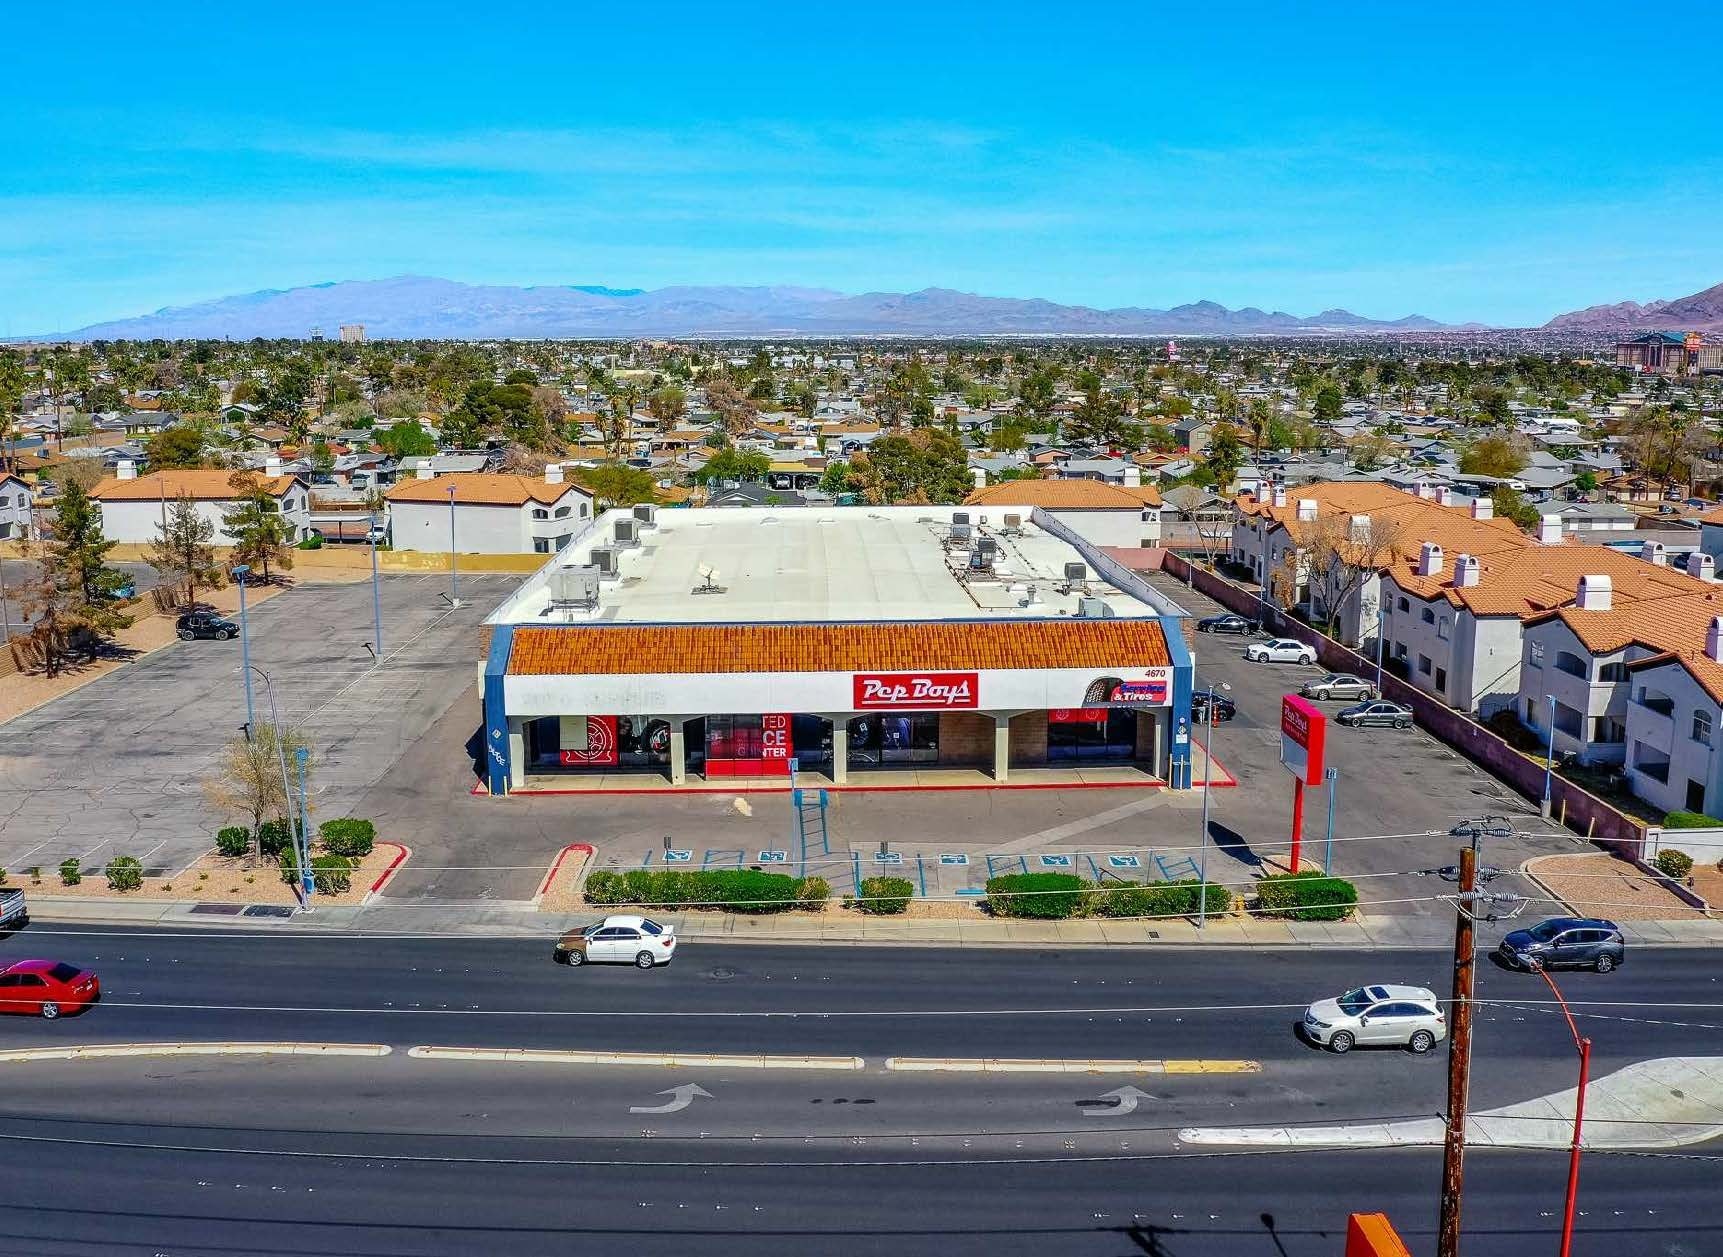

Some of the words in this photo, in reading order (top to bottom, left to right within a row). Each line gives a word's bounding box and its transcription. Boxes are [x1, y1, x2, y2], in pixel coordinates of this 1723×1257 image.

[1145, 669, 1166, 677] 4670
[863, 680, 909, 703] Pep
[911, 679, 971, 705] Boys
